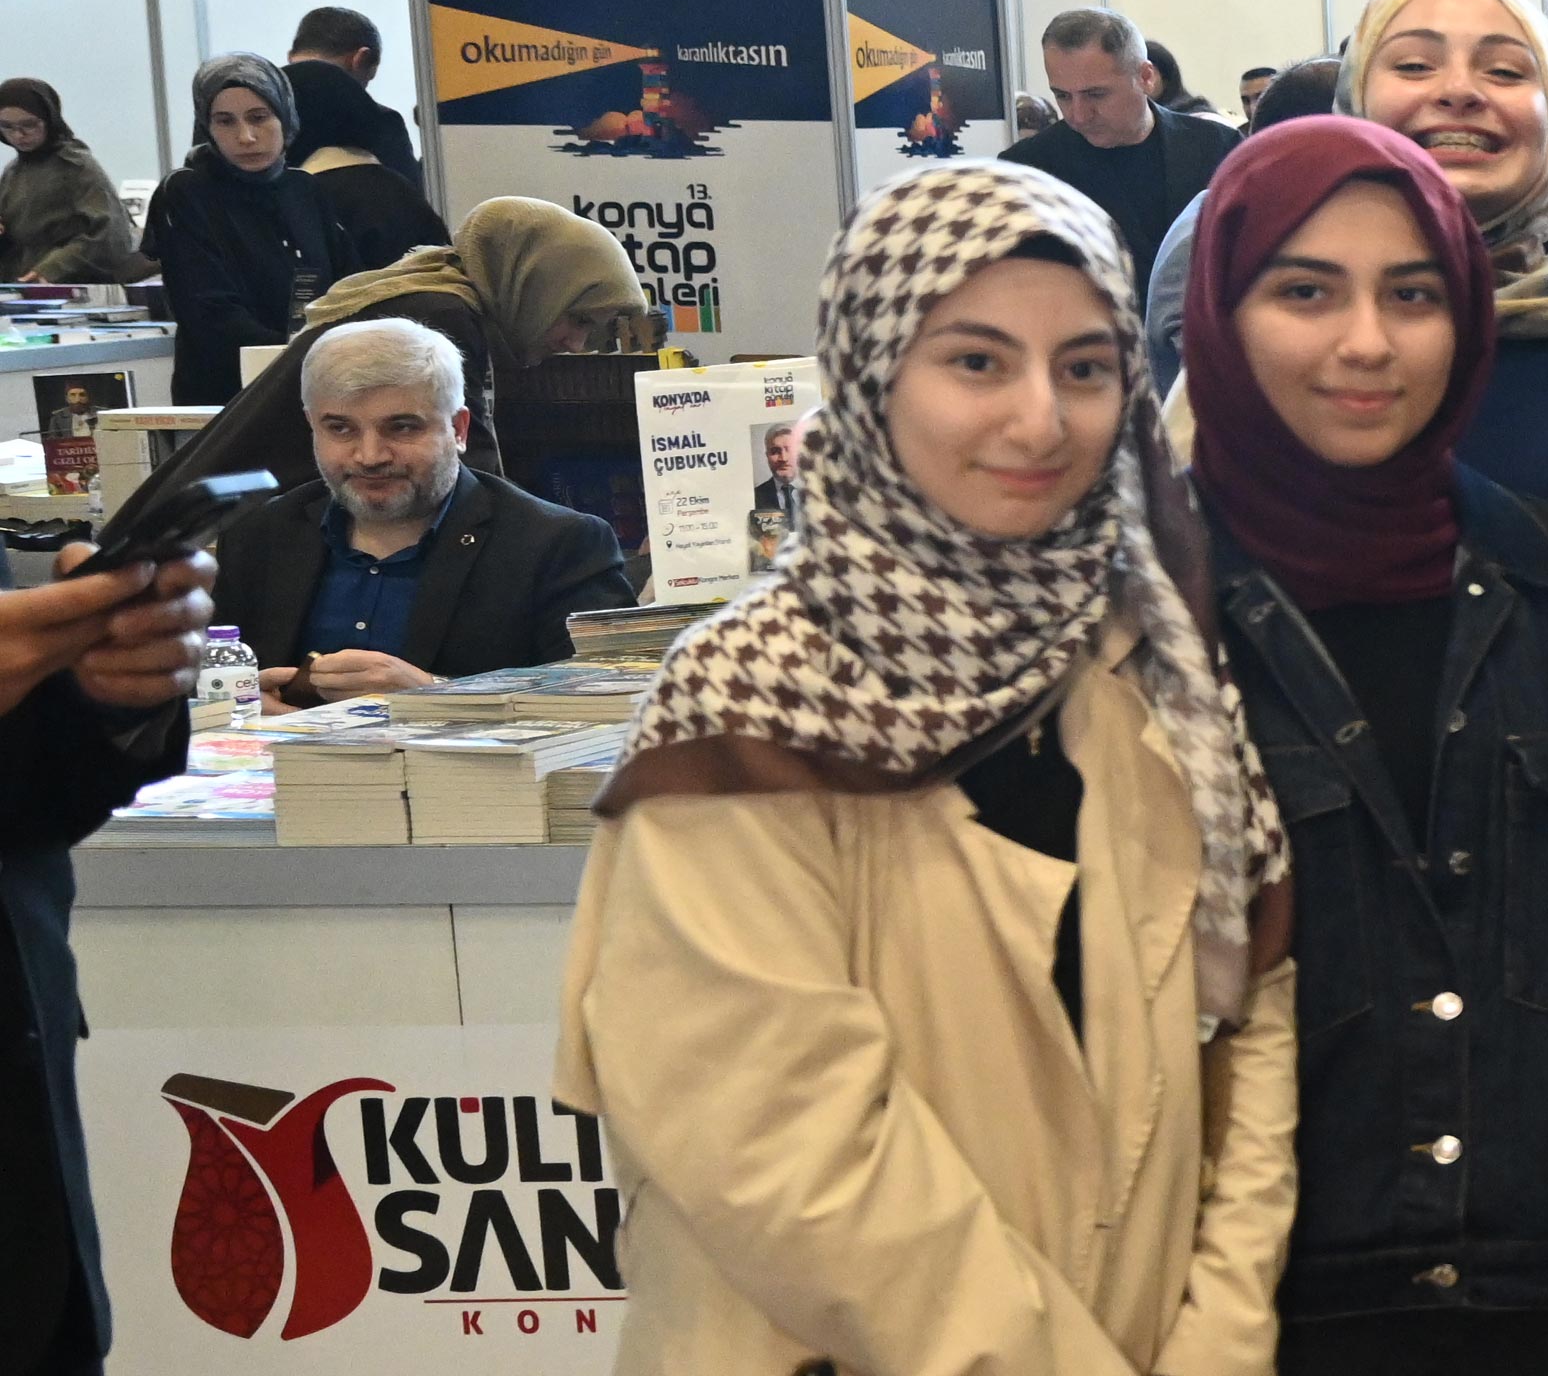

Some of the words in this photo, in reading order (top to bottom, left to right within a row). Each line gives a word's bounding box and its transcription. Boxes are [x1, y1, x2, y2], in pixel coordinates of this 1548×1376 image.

[461, 35, 588, 65] okumadığın
[677, 41, 788, 68] karanlıktasın
[686, 183, 712, 200] 13.
[573, 195, 714, 239] konya
[620, 231, 717, 281] tap
[640, 277, 720, 306] nleri
[651, 430, 706, 452] İSMAİL
[654, 451, 729, 476] ÇUBUKÇU
[676, 497, 688, 507] 22
[689, 496, 710, 505] Ekim
[462, 1310, 597, 1335] KON
